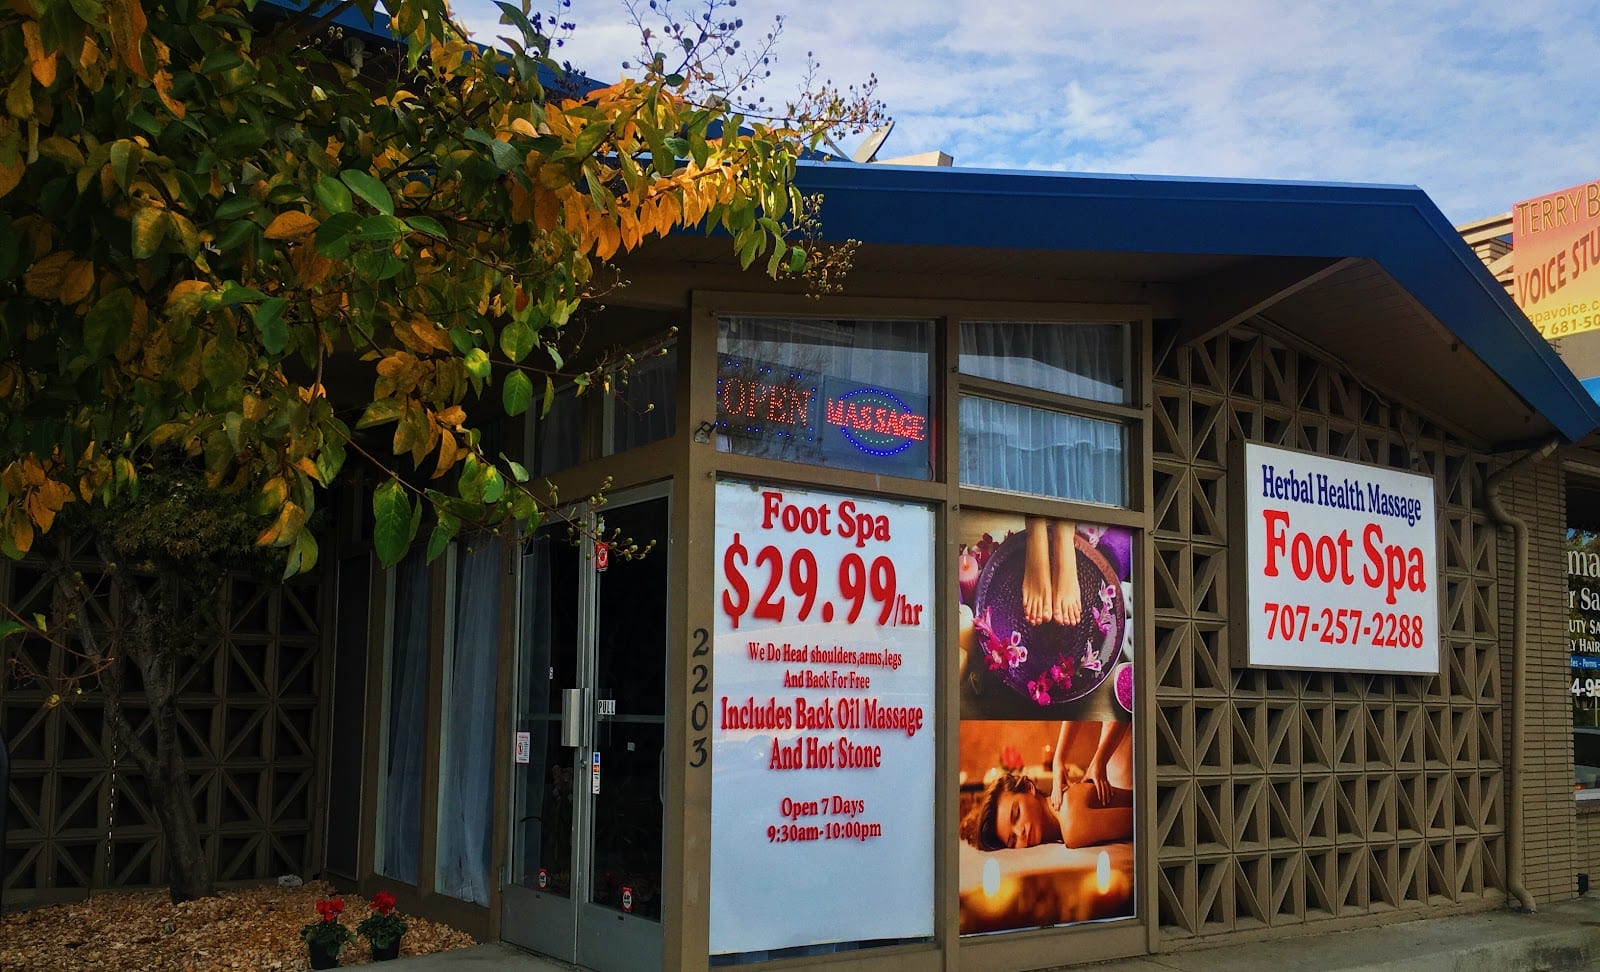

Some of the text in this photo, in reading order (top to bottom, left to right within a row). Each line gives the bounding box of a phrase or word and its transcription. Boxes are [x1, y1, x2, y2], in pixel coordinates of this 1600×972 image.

[1516, 190, 1582, 237] TERRY
[1517, 249, 1567, 309] VOICE
[723, 377, 811, 427] OPEN
[825, 397, 927, 441] MASSAGE
[1262, 464, 1422, 528] Herbal Health Massage
[761, 490, 891, 548] Foot Spa
[1262, 509, 1427, 605] Foot Spa
[1264, 602, 1424, 649] 707-257-2288
[748, 642, 902, 670] We Do Head shoulders,arms,legs
[689, 627, 709, 768] 2203
[784, 670, 871, 689] And Back For Free
[598, 700, 615, 714] PULL
[720, 696, 924, 737] Includes Back Oil Massage
[769, 736, 882, 770] And Hot Stone
[781, 795, 864, 821] Open 7 Days
[767, 822, 882, 844] 9:30am-10:00pm
